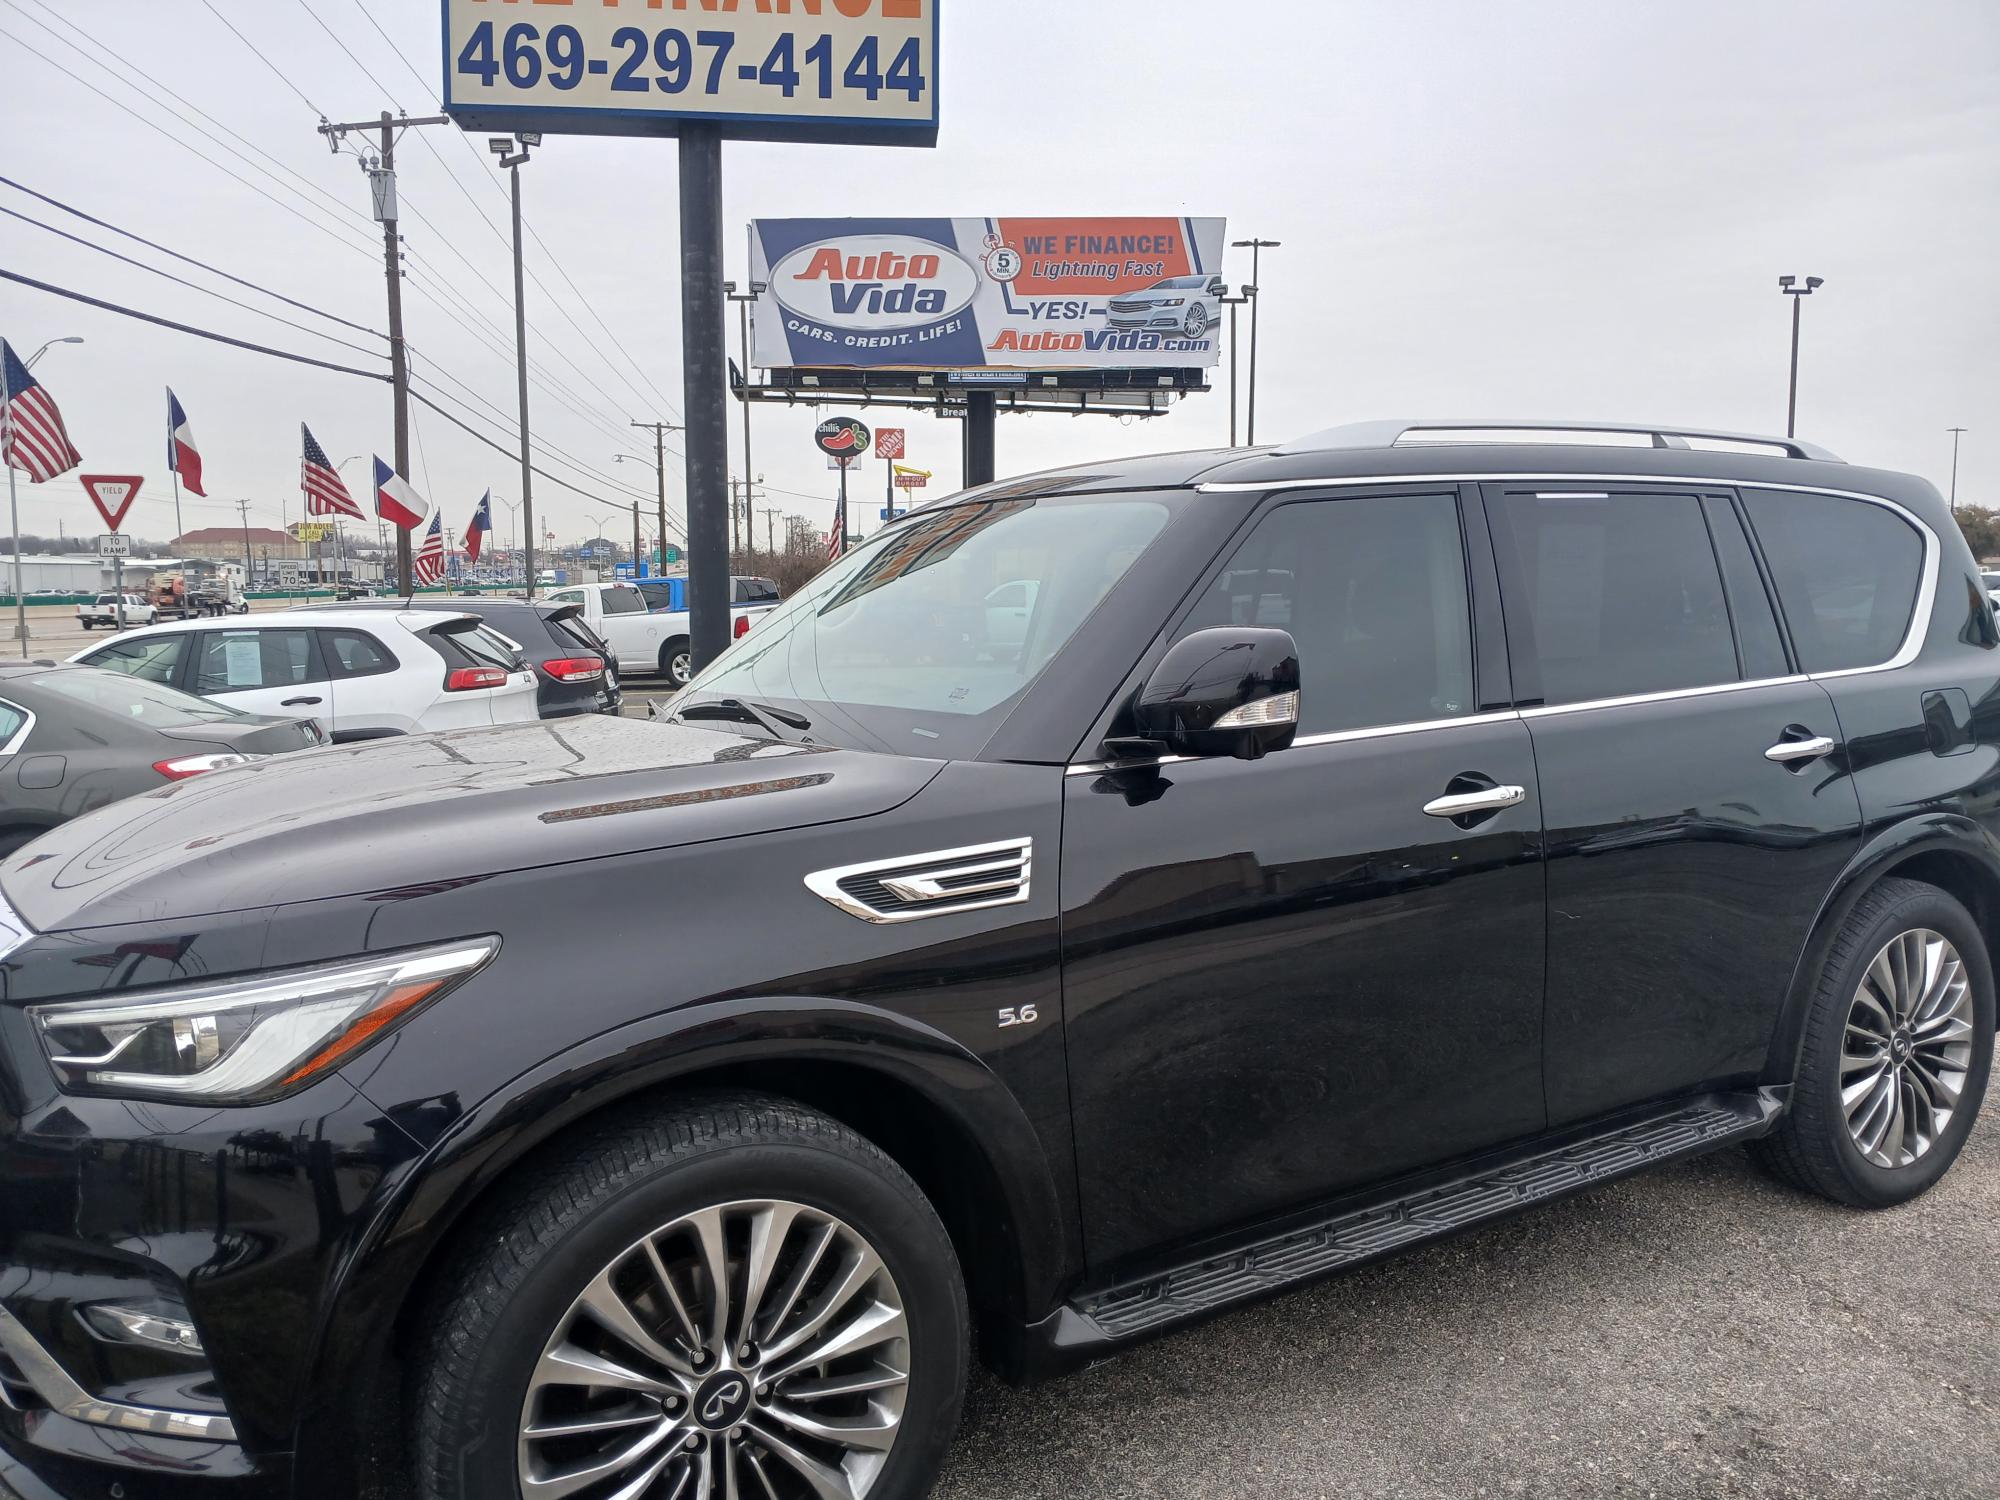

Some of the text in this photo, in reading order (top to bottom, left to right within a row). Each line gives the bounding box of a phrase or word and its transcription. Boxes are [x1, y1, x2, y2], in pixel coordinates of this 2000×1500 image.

[457, 21, 926, 102] 469-297-4144
[1023, 235, 1174, 255] WE FINANCE!
[793, 248, 940, 280] Auto
[998, 253, 1010, 268] 5
[1032, 260, 1164, 280] Lightning Fast
[830, 283, 947, 314] Vida
[1029, 301, 1089, 320] YES!
[787, 319, 962, 348] CARS. CREDIT. LIFE!
[986, 329, 1210, 352] AutoVida.com
[876, 429, 904, 458] HOME
[102, 486, 123, 495] YIELD
[103, 546, 127, 555] RAMP
[110, 537, 120, 546] TO
[283, 576, 296, 585] 70
